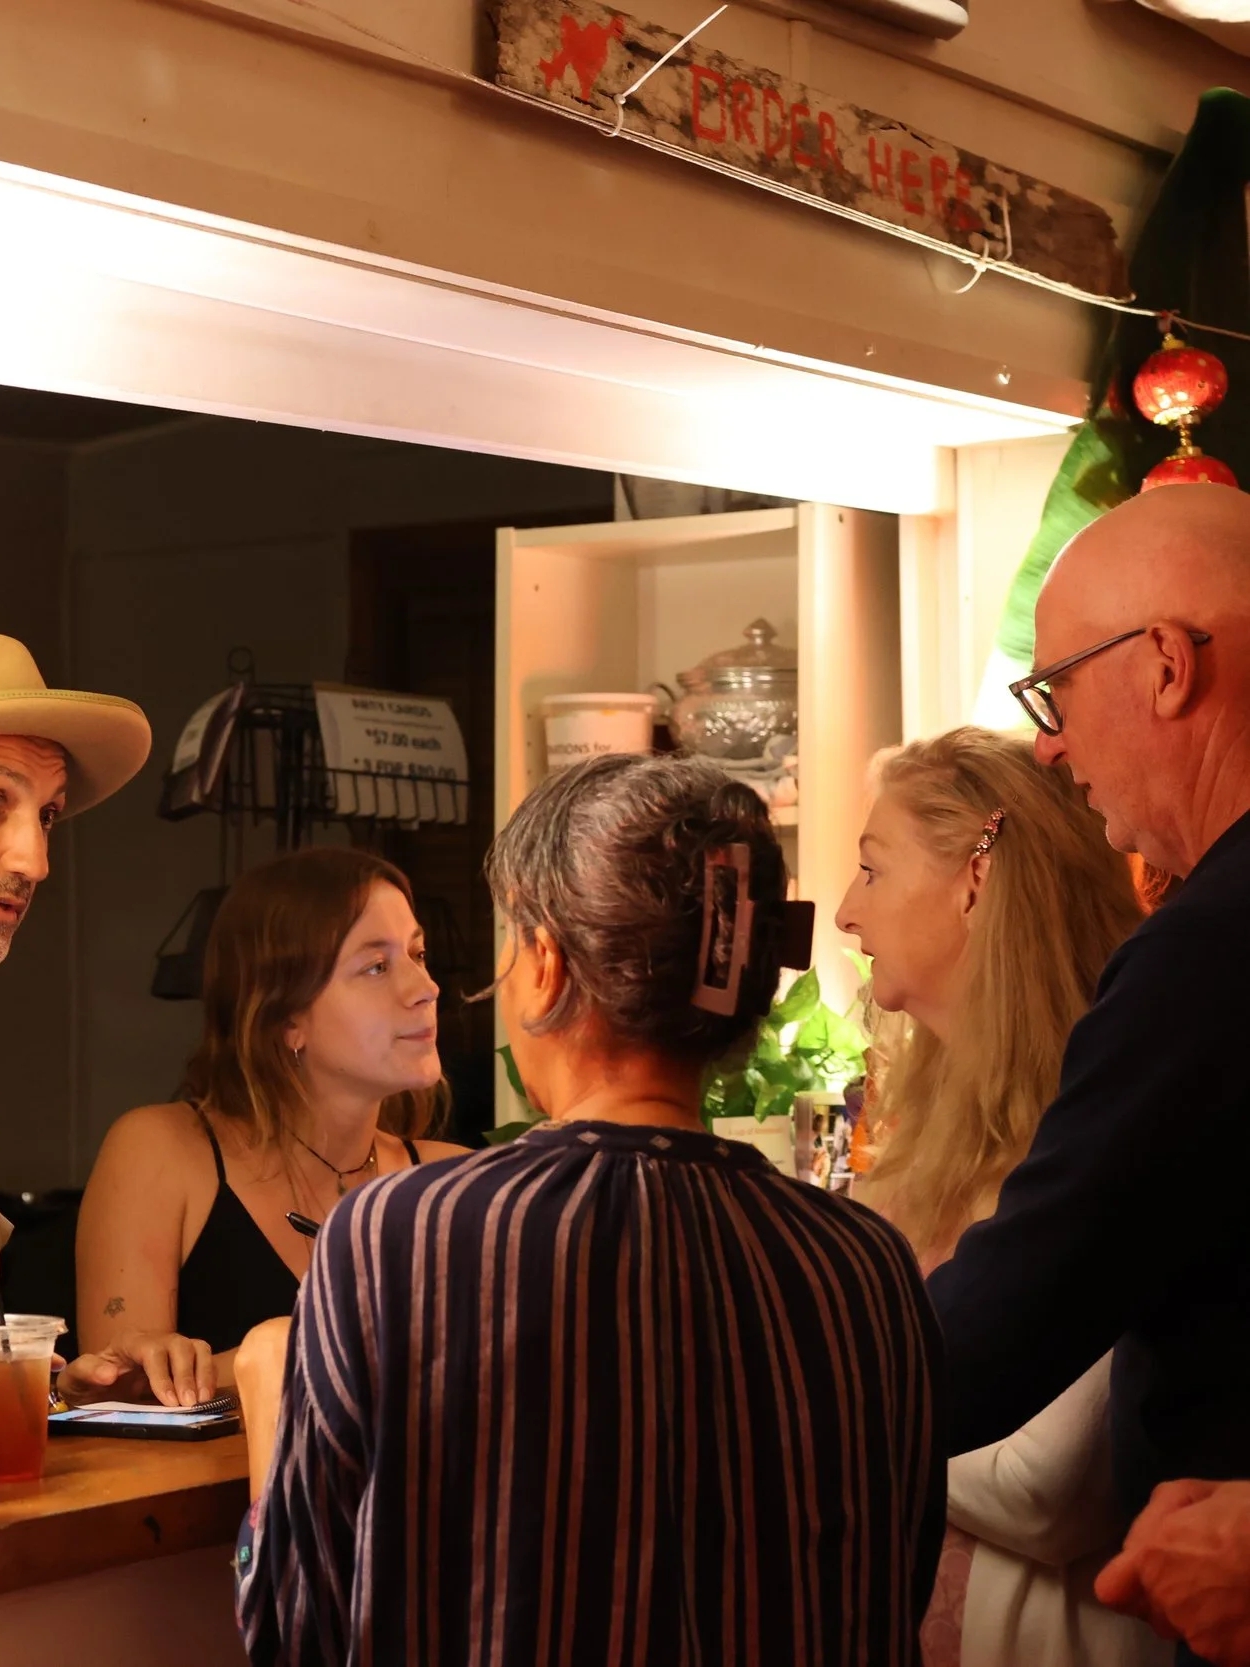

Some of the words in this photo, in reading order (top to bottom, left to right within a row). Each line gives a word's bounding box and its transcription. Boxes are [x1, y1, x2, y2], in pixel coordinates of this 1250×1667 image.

[689, 64, 844, 174] ORDER
[868, 136, 986, 232] HERE
[411, 736, 442, 750] each
